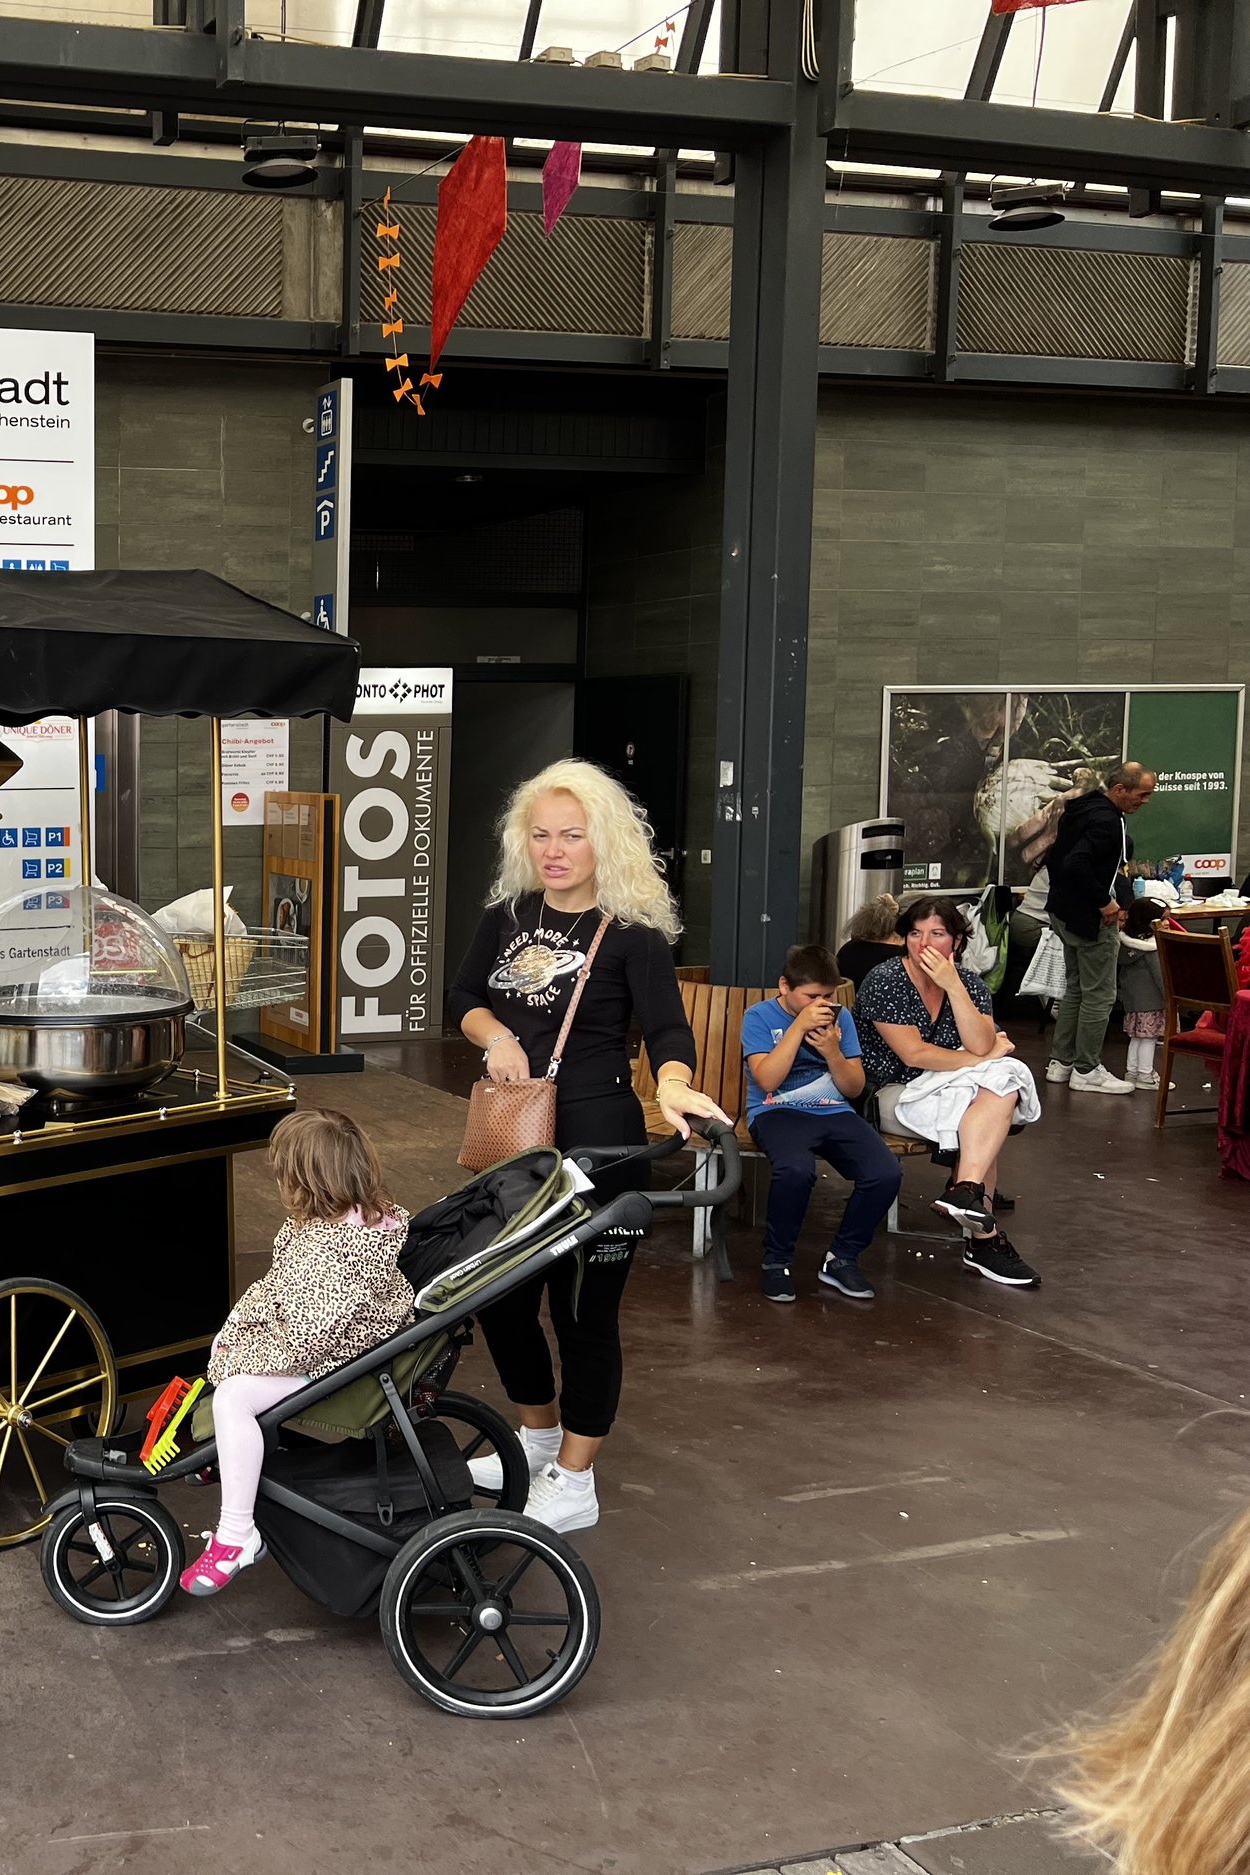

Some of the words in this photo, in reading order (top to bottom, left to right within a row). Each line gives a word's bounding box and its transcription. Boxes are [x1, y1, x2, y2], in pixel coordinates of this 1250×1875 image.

[413, 683, 445, 699] PHOT
[3, 726, 39, 736] UNIQUE
[40, 725, 72, 734] DÖNER
[1158, 771, 1174, 781] der
[1174, 771, 1207, 782] Knospe
[1153, 783, 1183, 792] Suisse
[1184, 782, 1201, 791] seit
[1202, 781, 1228, 791] 1993.
[413, 729, 434, 867] DOKUMENTE
[48, 831, 62, 843] P1
[47, 863, 63, 874] P2
[1194, 858, 1227, 871] coop
[341, 731, 411, 1034] FOTOS
[47, 895, 63, 906] P3
[409, 874, 431, 984] OFFIZIELLE
[503, 931, 530, 958] NEED
[533, 927, 570, 947] MORE
[9, 945, 71, 959] Gartenstadt
[526, 985, 562, 1007] SPACE
[405, 991, 426, 1032] FÜR
[549, 1234, 579, 1256] THULE
